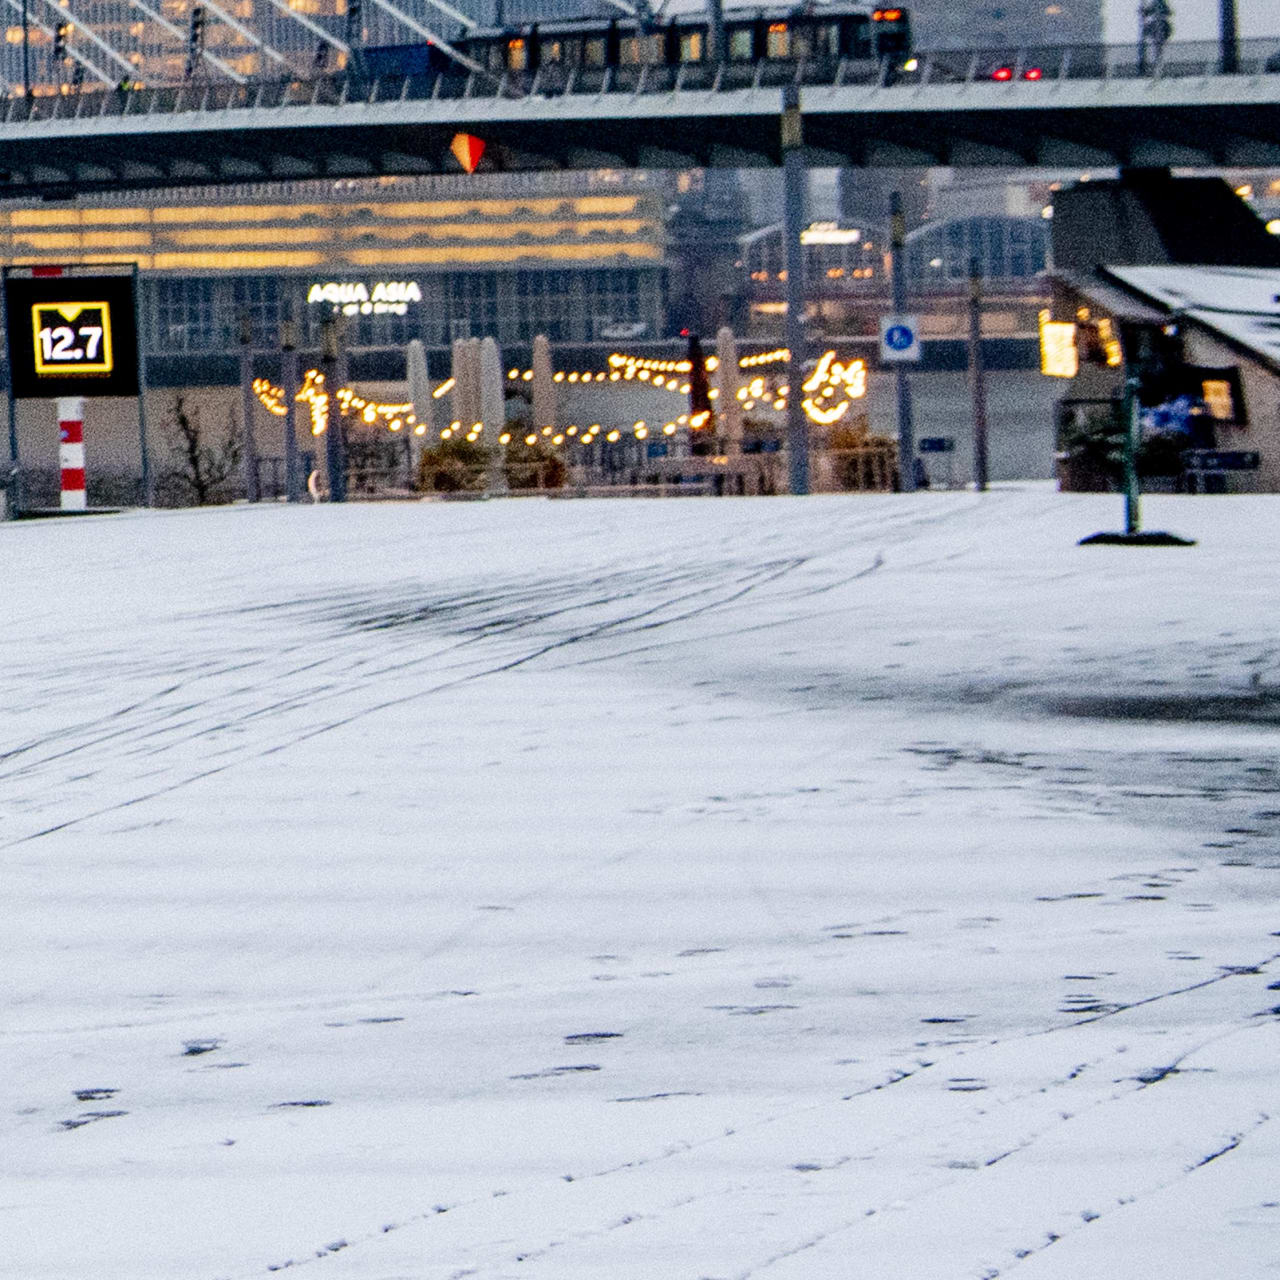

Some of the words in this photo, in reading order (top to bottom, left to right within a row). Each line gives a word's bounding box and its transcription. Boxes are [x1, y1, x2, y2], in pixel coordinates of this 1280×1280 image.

[307, 283, 368, 303] AQUA
[371, 281, 421, 302] ASIA
[39, 326, 102, 360] 12.7
